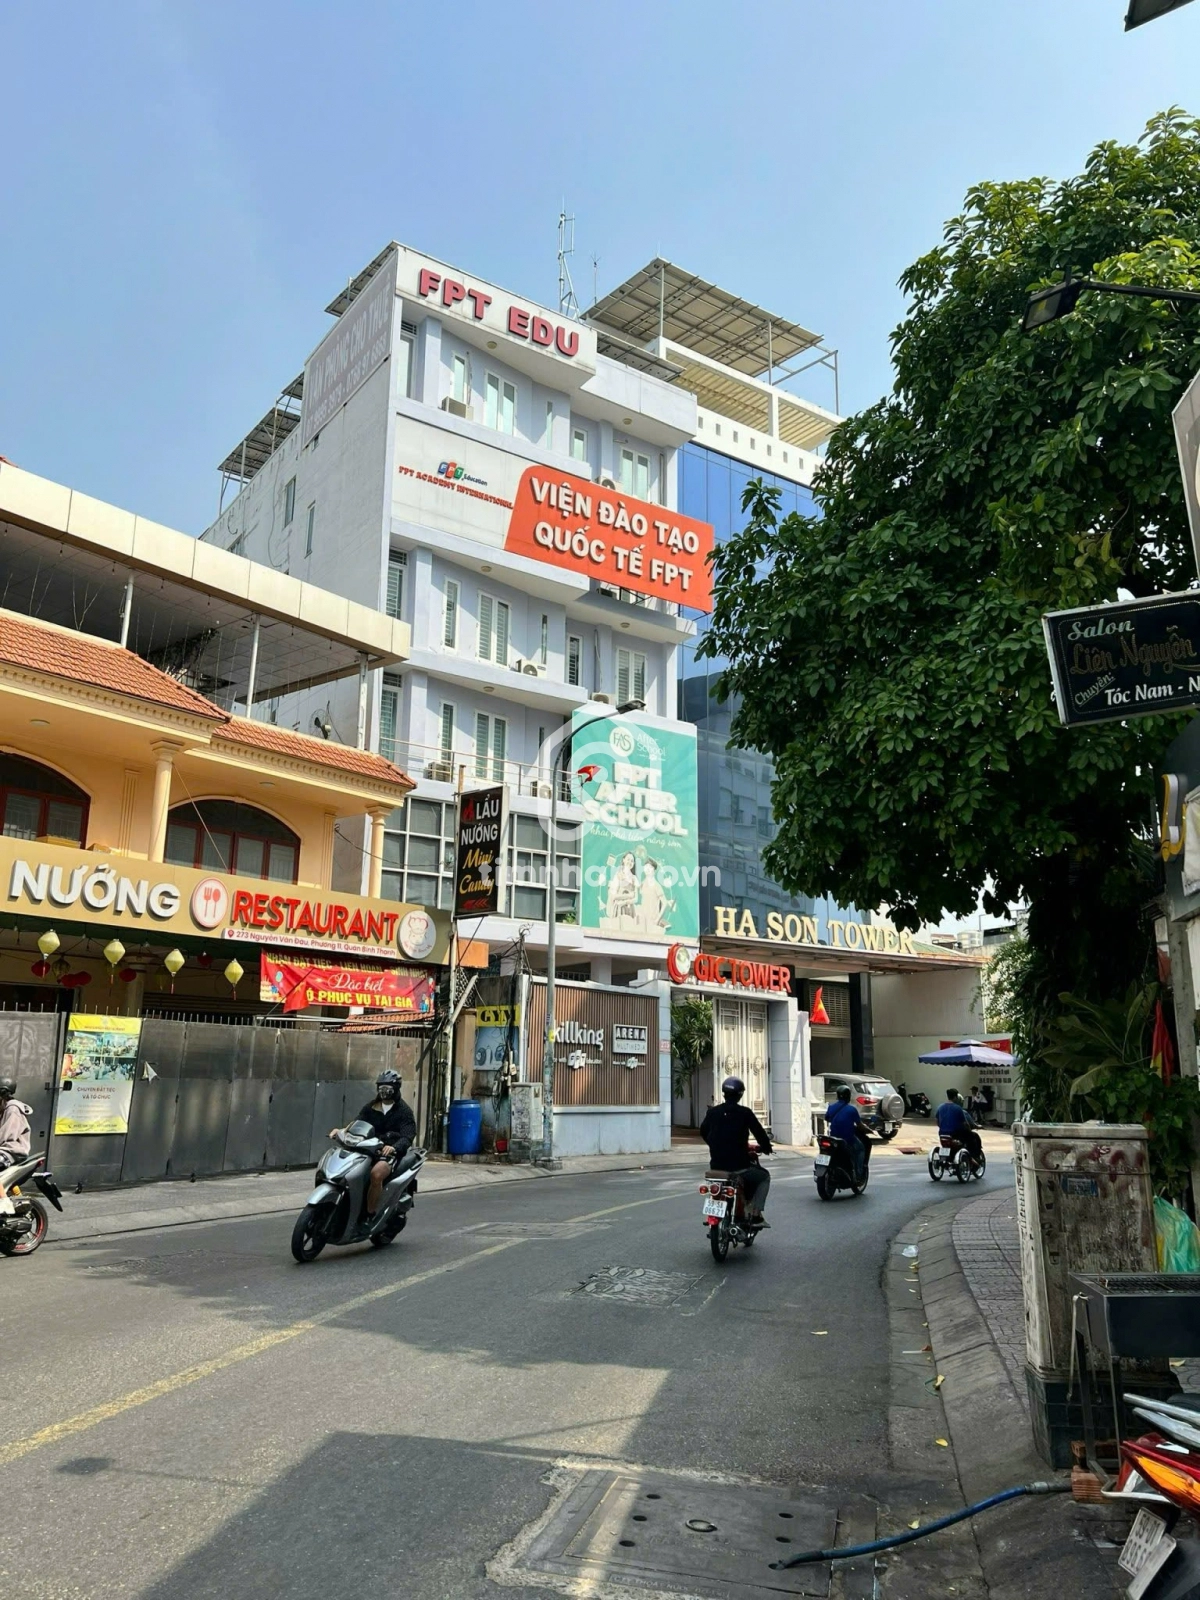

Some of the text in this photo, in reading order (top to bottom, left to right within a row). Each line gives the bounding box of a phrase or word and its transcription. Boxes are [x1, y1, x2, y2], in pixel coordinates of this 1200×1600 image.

[419, 268, 579, 357] FPT EDU
[398, 465, 514, 510] FPT ACADEMY INTERNATIONAL
[530, 476, 700, 554] VIỆN ĐÀO TẠO
[534, 521, 694, 591] QUỐC TẾ FPT
[1067, 618, 1135, 641] Salon
[1069, 625, 1198, 677] Liên Nguyễn
[1104, 688, 1131, 706] Tóc
[1135, 683, 1174, 701] Nam
[612, 761, 662, 789] FPT
[476, 793, 500, 820] LẨU
[594, 780, 677, 814] AFTER
[461, 823, 498, 846] NƯỚNG
[582, 799, 689, 837] SCHOOL
[10, 860, 400, 942] NƯỚNG RESTAURANT
[459, 874, 495, 896] Candy
[714, 905, 918, 955] HA SON TOWER
[693, 953, 792, 994] GIC TOWER
[318, 990, 353, 1006] PHỤC
[355, 993, 371, 1007] VỤ
[394, 996, 413, 1008] GIA
[553, 1020, 604, 1051] killking
[616, 1027, 646, 1040] ARENA
